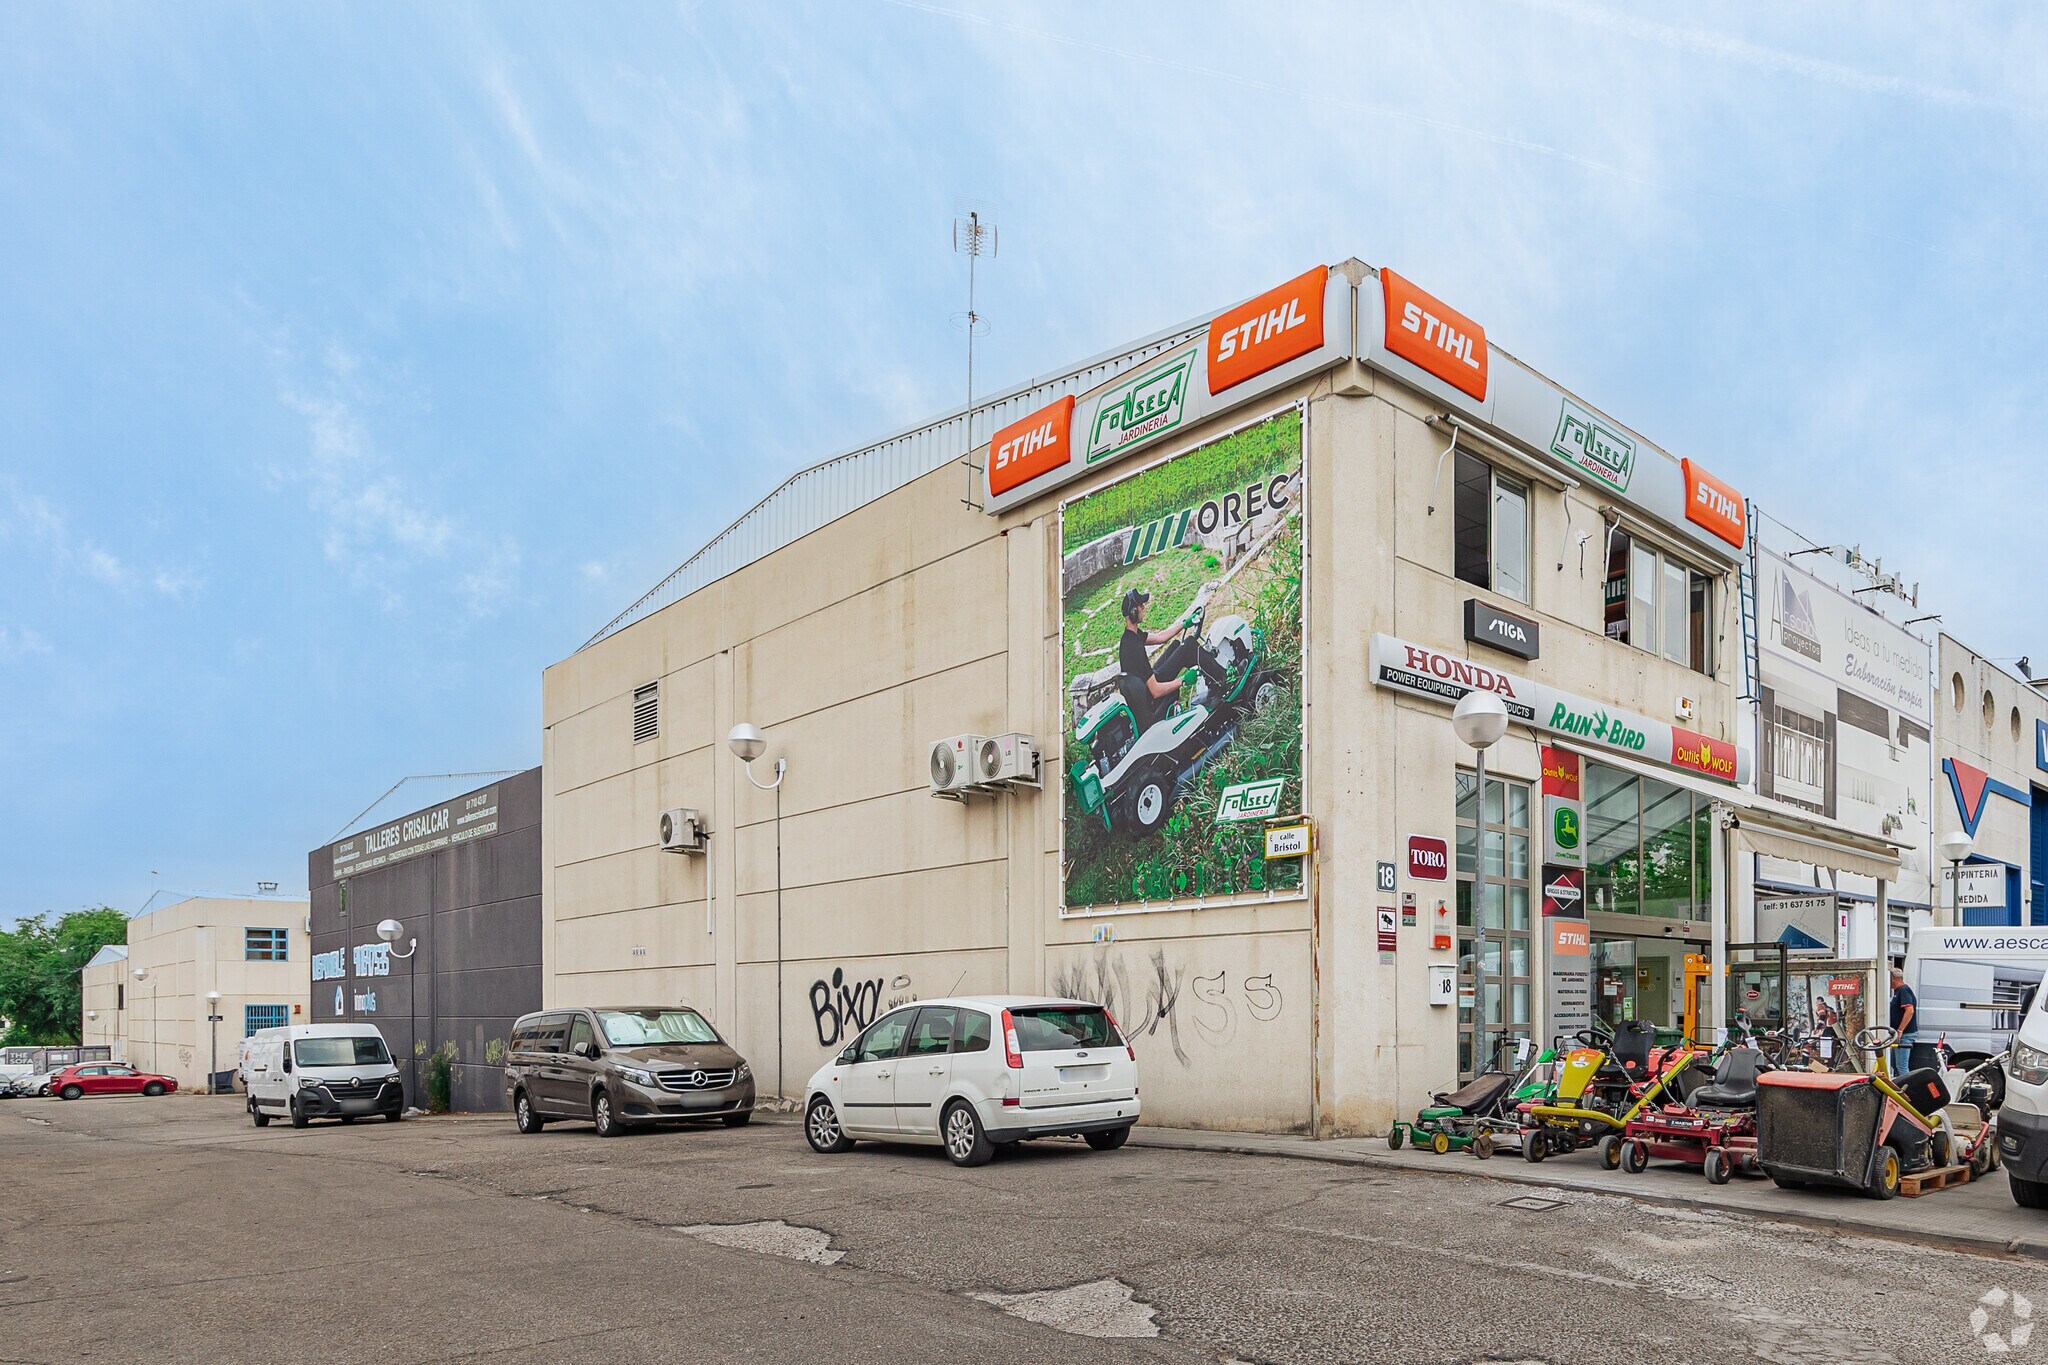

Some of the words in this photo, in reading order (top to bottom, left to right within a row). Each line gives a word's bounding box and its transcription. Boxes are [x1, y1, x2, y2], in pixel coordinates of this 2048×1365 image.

[1216, 297, 1306, 363] STIHL
[1401, 301, 1480, 370] STIHL
[995, 420, 1057, 471] STIHL
[1197, 473, 1290, 536] OREC
[1696, 481, 1741, 526] STIHL
[1489, 618, 1527, 643] STIGA
[1783, 630, 1821, 655] proyectos
[1844, 617, 1870, 653] Ideas
[1873, 643, 1880, 657] a
[1883, 641, 1890, 663] tu
[1892, 650, 1923, 681] medida
[1386, 668, 1416, 686] POWER
[1417, 677, 1462, 698] EQUIPMENT
[1404, 645, 1516, 698] HONDA
[1845, 653, 1896, 696] Elaboración
[1898, 684, 1923, 708] propia
[1548, 702, 1593, 737] RAIN
[1607, 719, 1646, 751] BIRD
[1677, 746, 1700, 765] Outils
[1711, 756, 1733, 774] WOLF
[1564, 772, 1578, 782] WOLF
[364, 825, 400, 854] TALLERES
[403, 808, 449, 842] CRISALCAR
[1279, 832, 1295, 841] calle
[1274, 841, 1300, 852] Bristol
[1379, 865, 1394, 888] 18
[1968, 882, 1974, 891] A
[1763, 903, 1778, 911] telf:
[1779, 901, 1788, 909] 91
[1790, 900, 1803, 908] 637
[1805, 900, 1814, 908] 51
[1816, 899, 1826, 907] 75
[1958, 894, 1988, 903] MEDIDA
[1558, 932, 1587, 946] STIHL
[1442, 979, 1451, 994] 18
